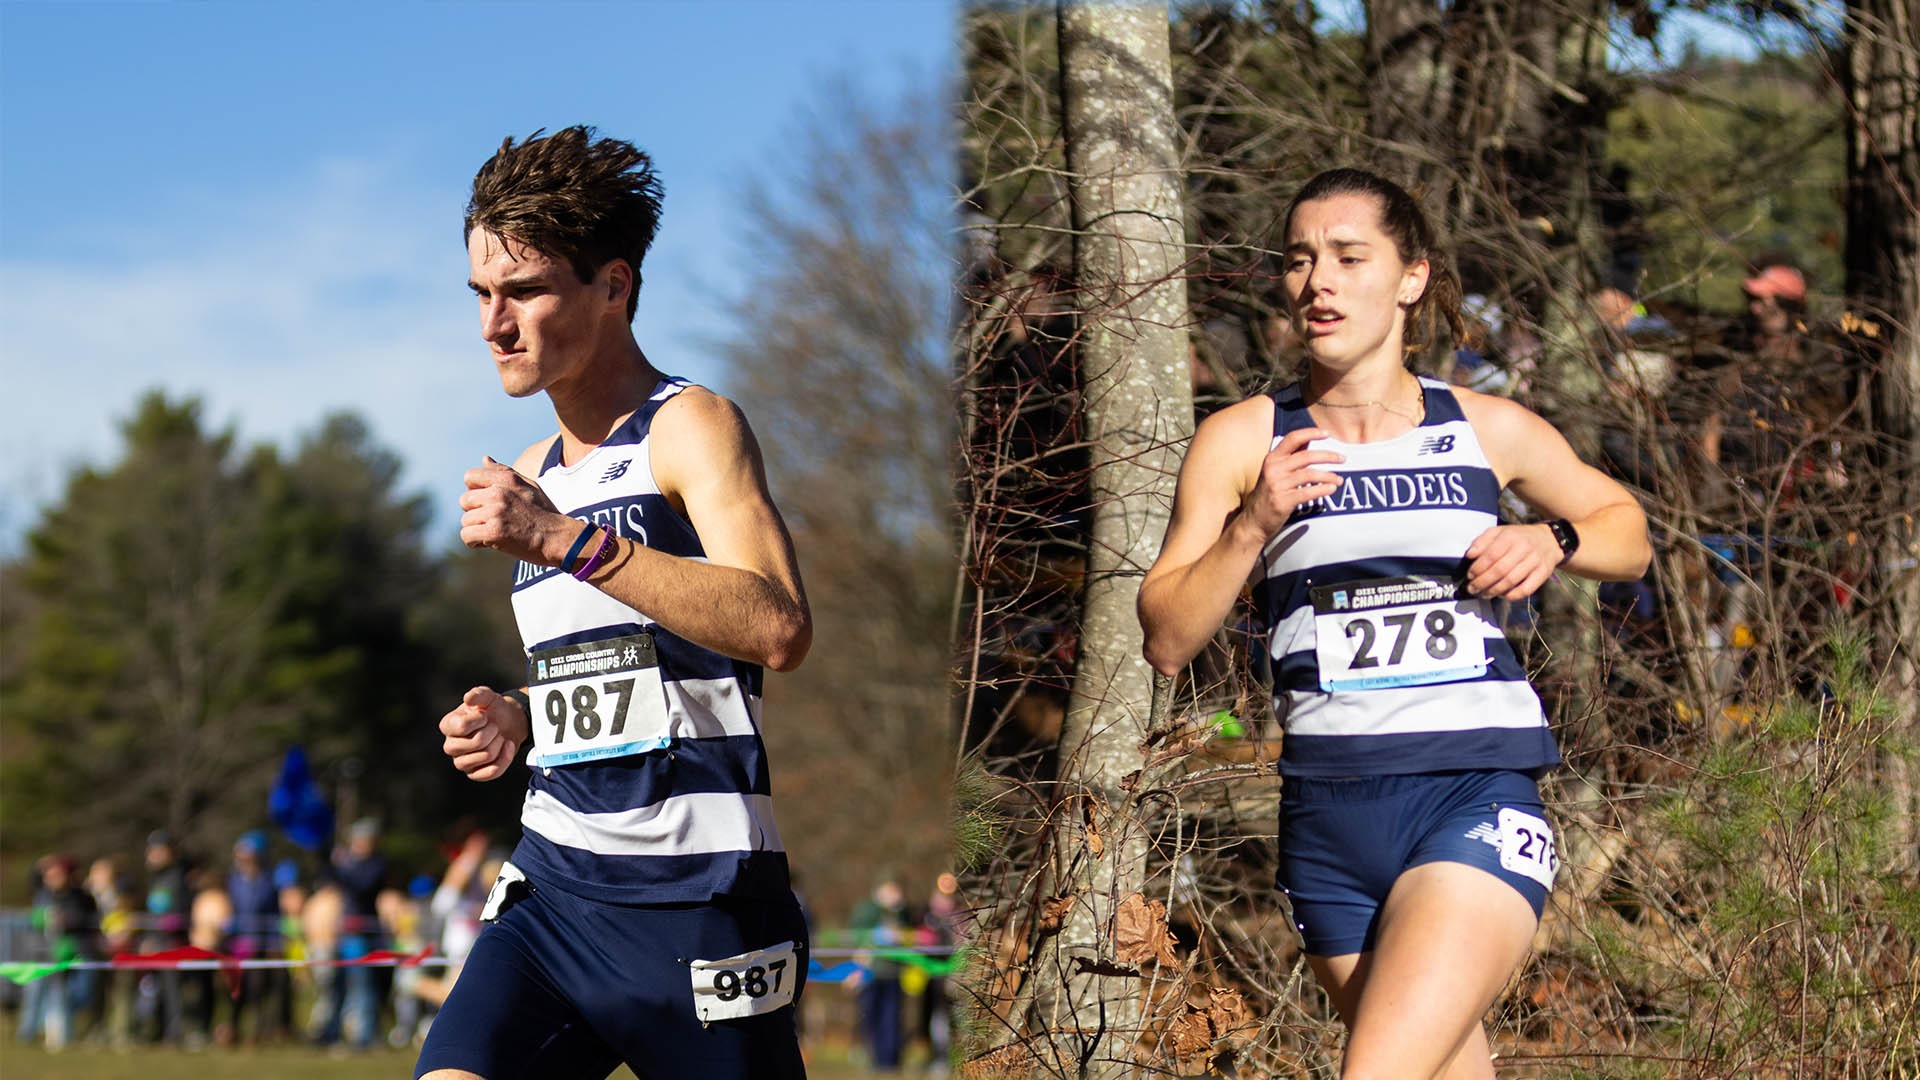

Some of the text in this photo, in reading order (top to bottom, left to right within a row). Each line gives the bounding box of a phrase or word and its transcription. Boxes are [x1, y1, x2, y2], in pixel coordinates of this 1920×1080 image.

[1296, 472, 1468, 512] RANDEIS
[1352, 586, 1443, 609] CHAMPIONSHIPS
[1377, 584, 1404, 594] CROSS
[1345, 609, 1458, 670] 278
[549, 656, 620, 678] CHAMPIONSHIPS
[566, 652, 585, 663] CROSS
[585, 648, 616, 659] COUNTRY
[545, 677, 636, 744] 987
[713, 959, 787, 1002] 987
